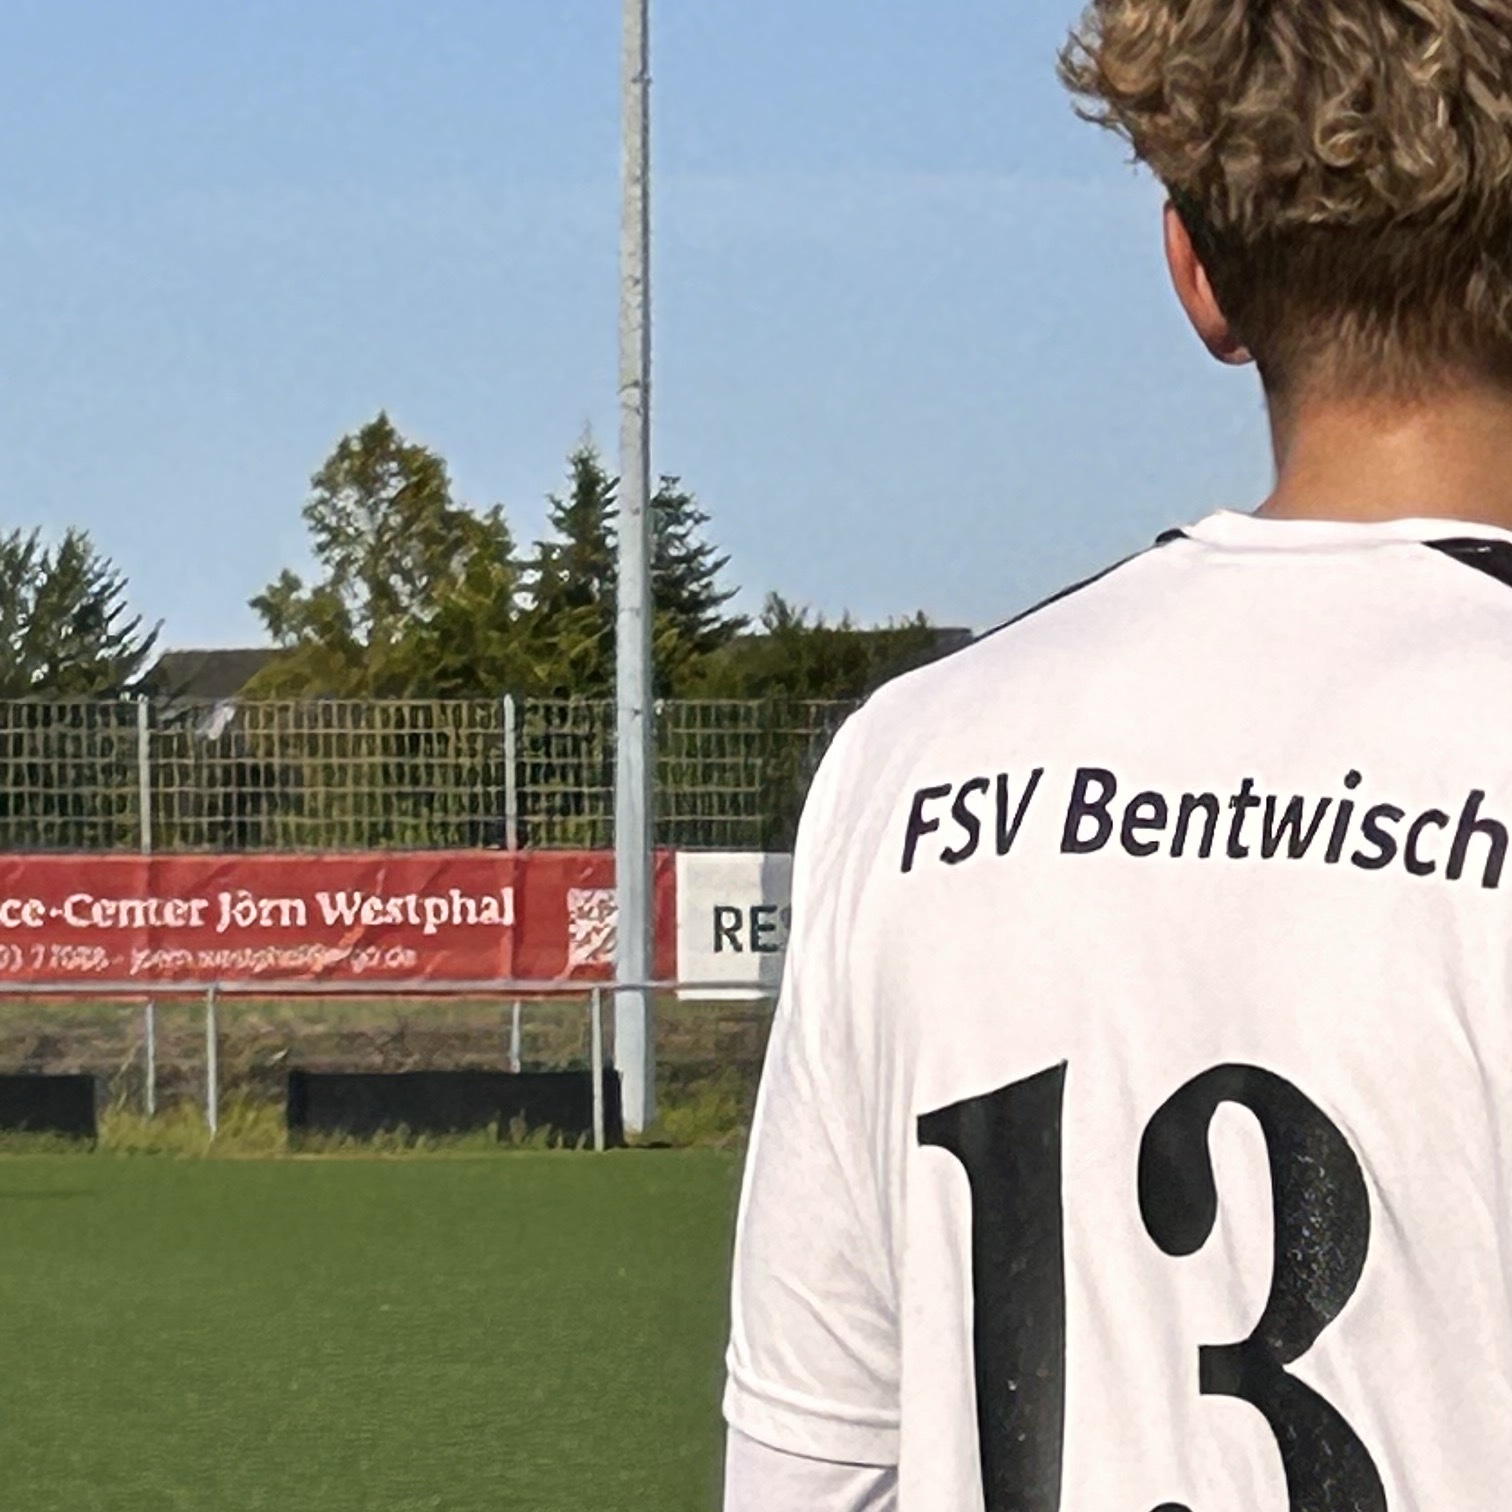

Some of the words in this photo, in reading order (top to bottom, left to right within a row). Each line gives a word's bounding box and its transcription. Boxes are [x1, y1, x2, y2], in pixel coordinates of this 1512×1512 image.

[900, 767, 1044, 873] FSV
[1061, 767, 1508, 889] Bentwisch
[216, 889, 307, 932] Jörn
[316, 887, 515, 934] Westphal
